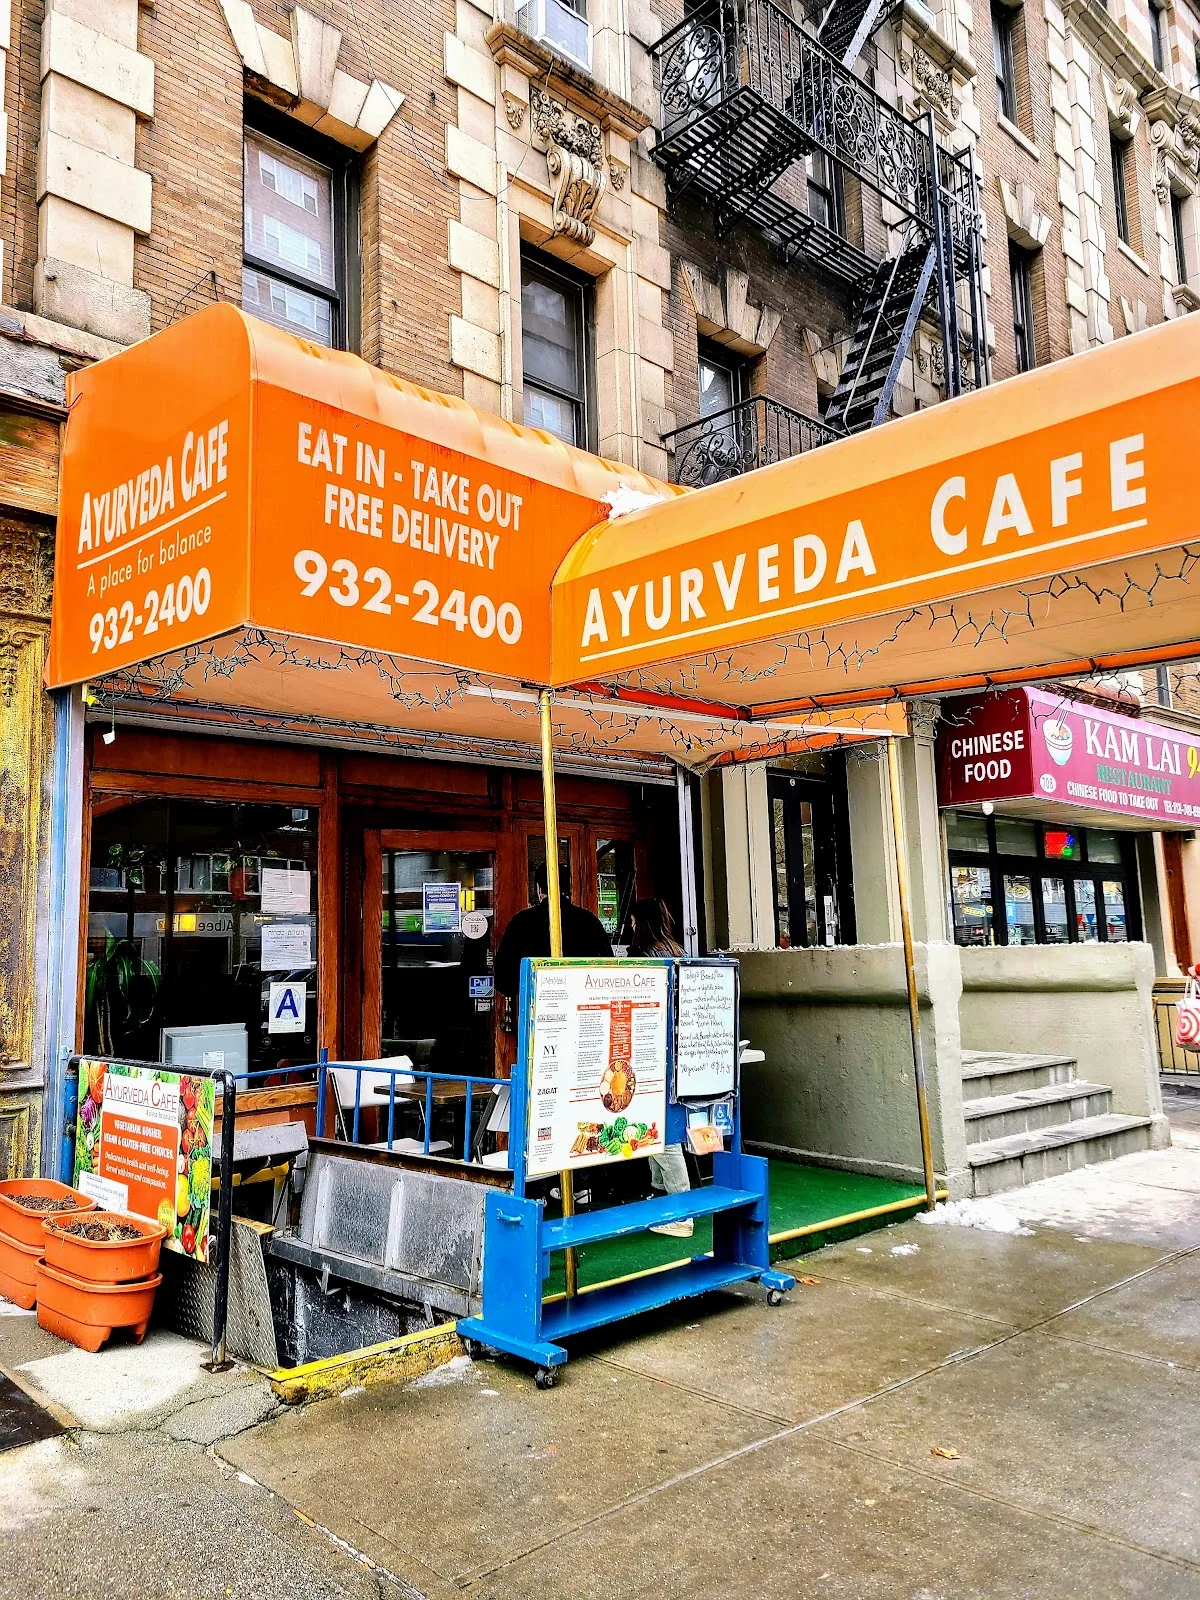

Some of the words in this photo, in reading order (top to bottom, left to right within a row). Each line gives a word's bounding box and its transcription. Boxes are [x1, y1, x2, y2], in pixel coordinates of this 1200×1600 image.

[77, 455, 174, 555] AYURVEDA
[181, 420, 228, 502] CAFE
[297, 422, 348, 475] EAT
[356, 441, 385, 488] IN
[394, 472, 403, 482] -
[411, 460, 470, 515] TAKE
[477, 483, 523, 531] OUT
[324, 483, 384, 538] FREE
[392, 504, 500, 570] DELIVERY
[581, 519, 877, 647] AYURVEDA
[930, 433, 1147, 556] CAFE
[87, 573, 96, 597] A
[100, 564, 132, 600] place
[137, 551, 155, 573] for
[159, 526, 212, 567] balance
[89, 567, 211, 654] 932-2400
[293, 549, 523, 645] 932-2400
[951, 729, 1024, 759] CHINESE
[1083, 718, 1140, 767] KAM
[1144, 736, 1182, 776] LAI
[1186, 746, 1200, 778] 9
[964, 758, 1012, 782] FOOD
[1096, 764, 1172, 796] RESTAURANT
[1067, 781, 1098, 800] CHINESE
[1098, 788, 1118, 804] FOOD
[1118, 792, 1128, 806] TO
[1128, 794, 1146, 809] TAKE
[1146, 798, 1159, 811] OUT
[474, 978, 490, 987] Pull
[585, 974, 631, 988] AYURVEDA
[633, 974, 655, 986] CAFE
[275, 989, 299, 1018] A
[543, 1045, 557, 1055] NY
[105, 1075, 149, 1105] AYURVEDA
[151, 1082, 178, 1110] CAFE
[537, 1087, 558, 1095] ZAGAT
[104, 1132, 118, 1144] VEGAN
[122, 1138, 151, 1153] GLUTEN-FREE
[105, 1151, 121, 1162] Dedicated
[126, 1157, 138, 1167] health
[106, 1164, 118, 1174] Served
